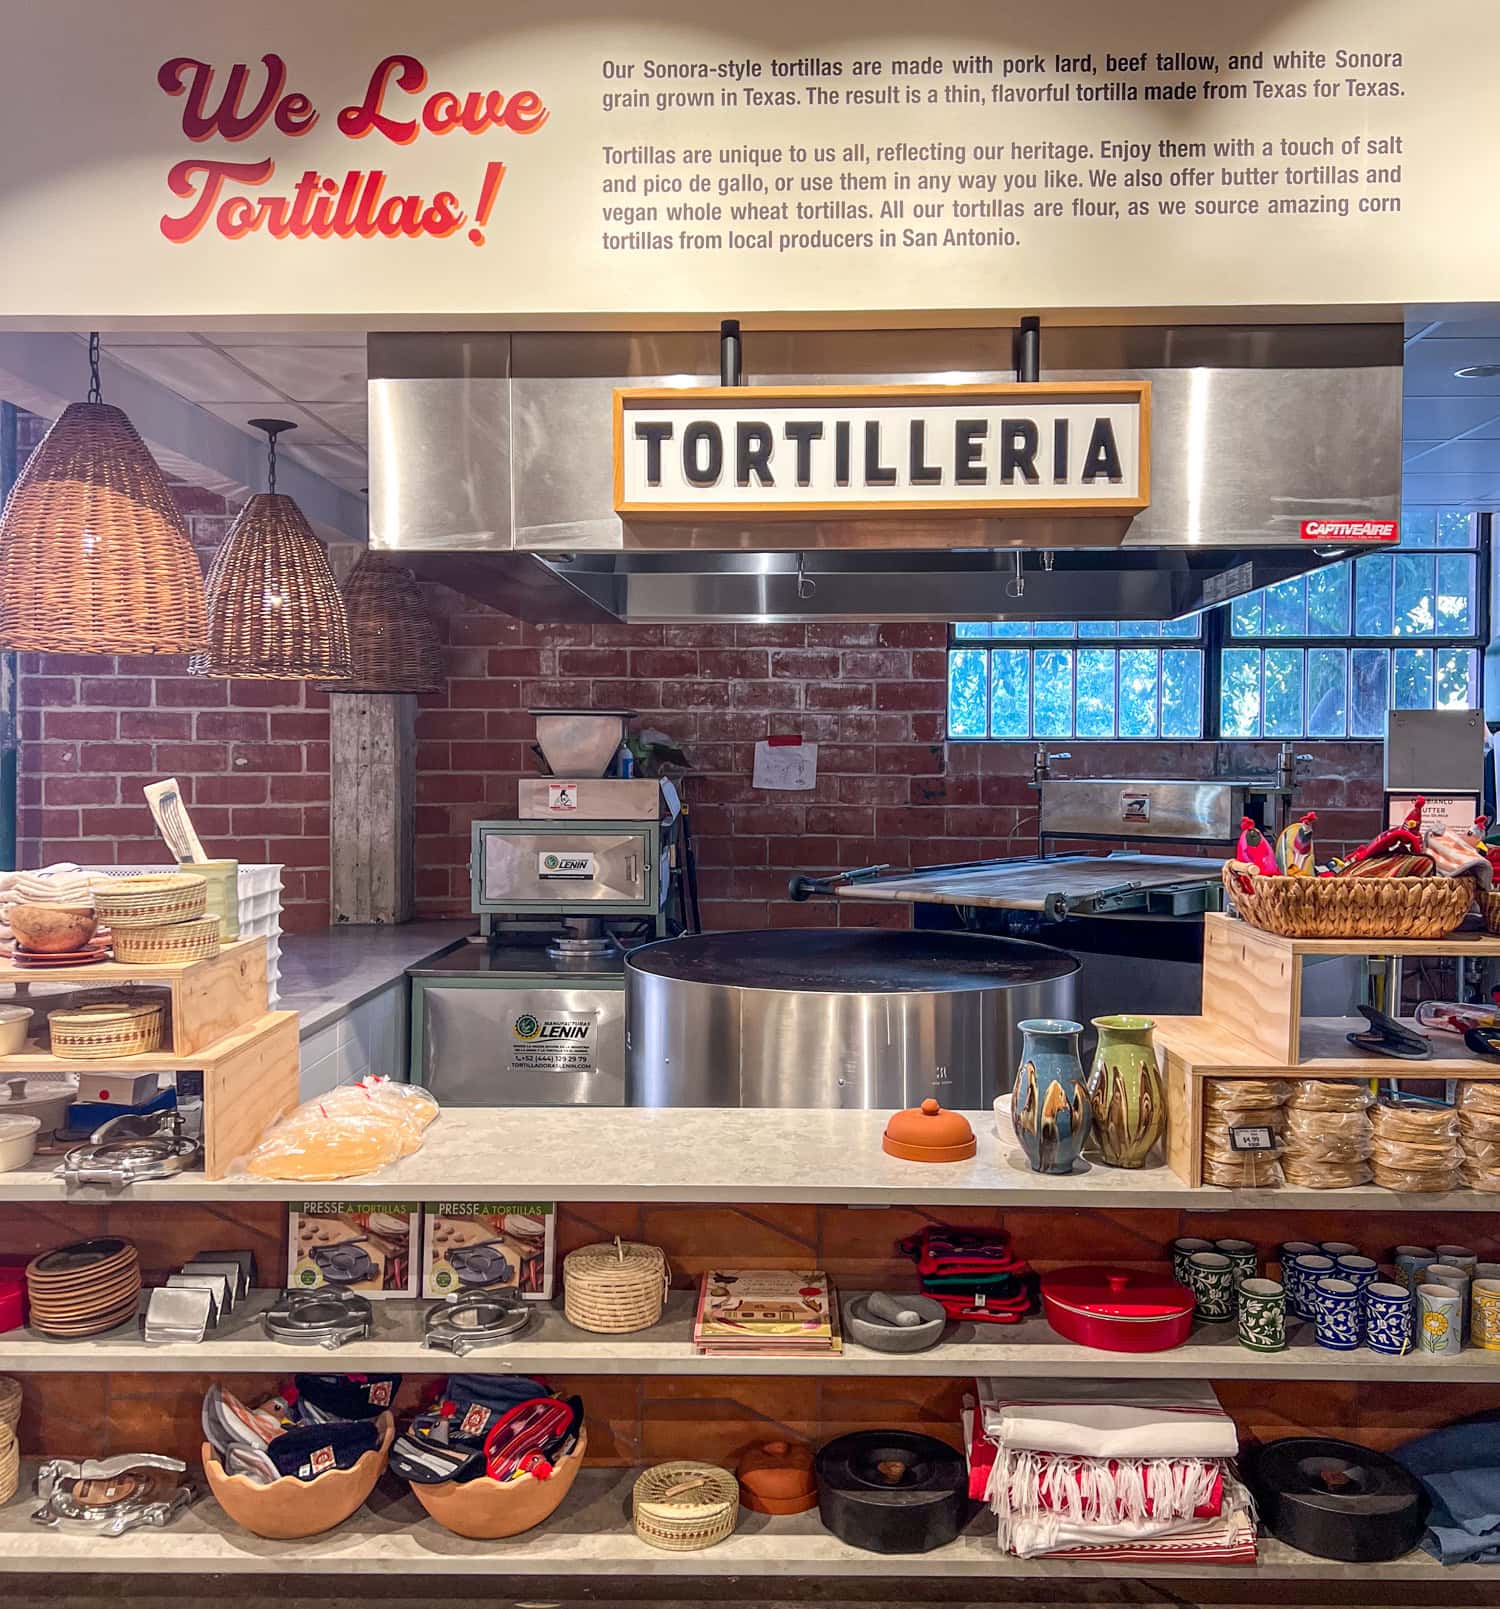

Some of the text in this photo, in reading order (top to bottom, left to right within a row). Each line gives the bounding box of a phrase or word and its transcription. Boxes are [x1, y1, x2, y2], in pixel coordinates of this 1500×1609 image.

[602, 49, 1403, 82] Our Sonora-style tortillas are made with pork lard, beef tallow, and white Sonora
[157, 53, 550, 146] We Love
[602, 78, 1405, 112] grain grown in Texas. The result is a thin, flavorful tortilla made from Texas for Texas.
[601, 135, 1403, 168] Tortillas are unique to us all, reflecting our heritage. Enjoy them with a touch of salt
[602, 164, 1402, 197] and pico de gallo, or use them in any way you like. We also offer butter tortillas and
[158, 157, 507, 248] Tortillas!
[602, 194, 1401, 226] vegan whole wheat tortillas. All our tortillas are flour, as we source amazing corn
[601, 227, 1021, 253] tortillas from local producers in San Antonio.
[634, 417, 1123, 488] TORTILLERIA
[559, 859, 588, 869] LENIN
[540, 1026, 589, 1038] LENIN
[303, 1202, 345, 1214] PRESSE
[357, 1204, 407, 1214] TORTILLAS
[439, 1203, 479, 1216] PRESSE
[491, 1205, 542, 1216] TORTILLAS
